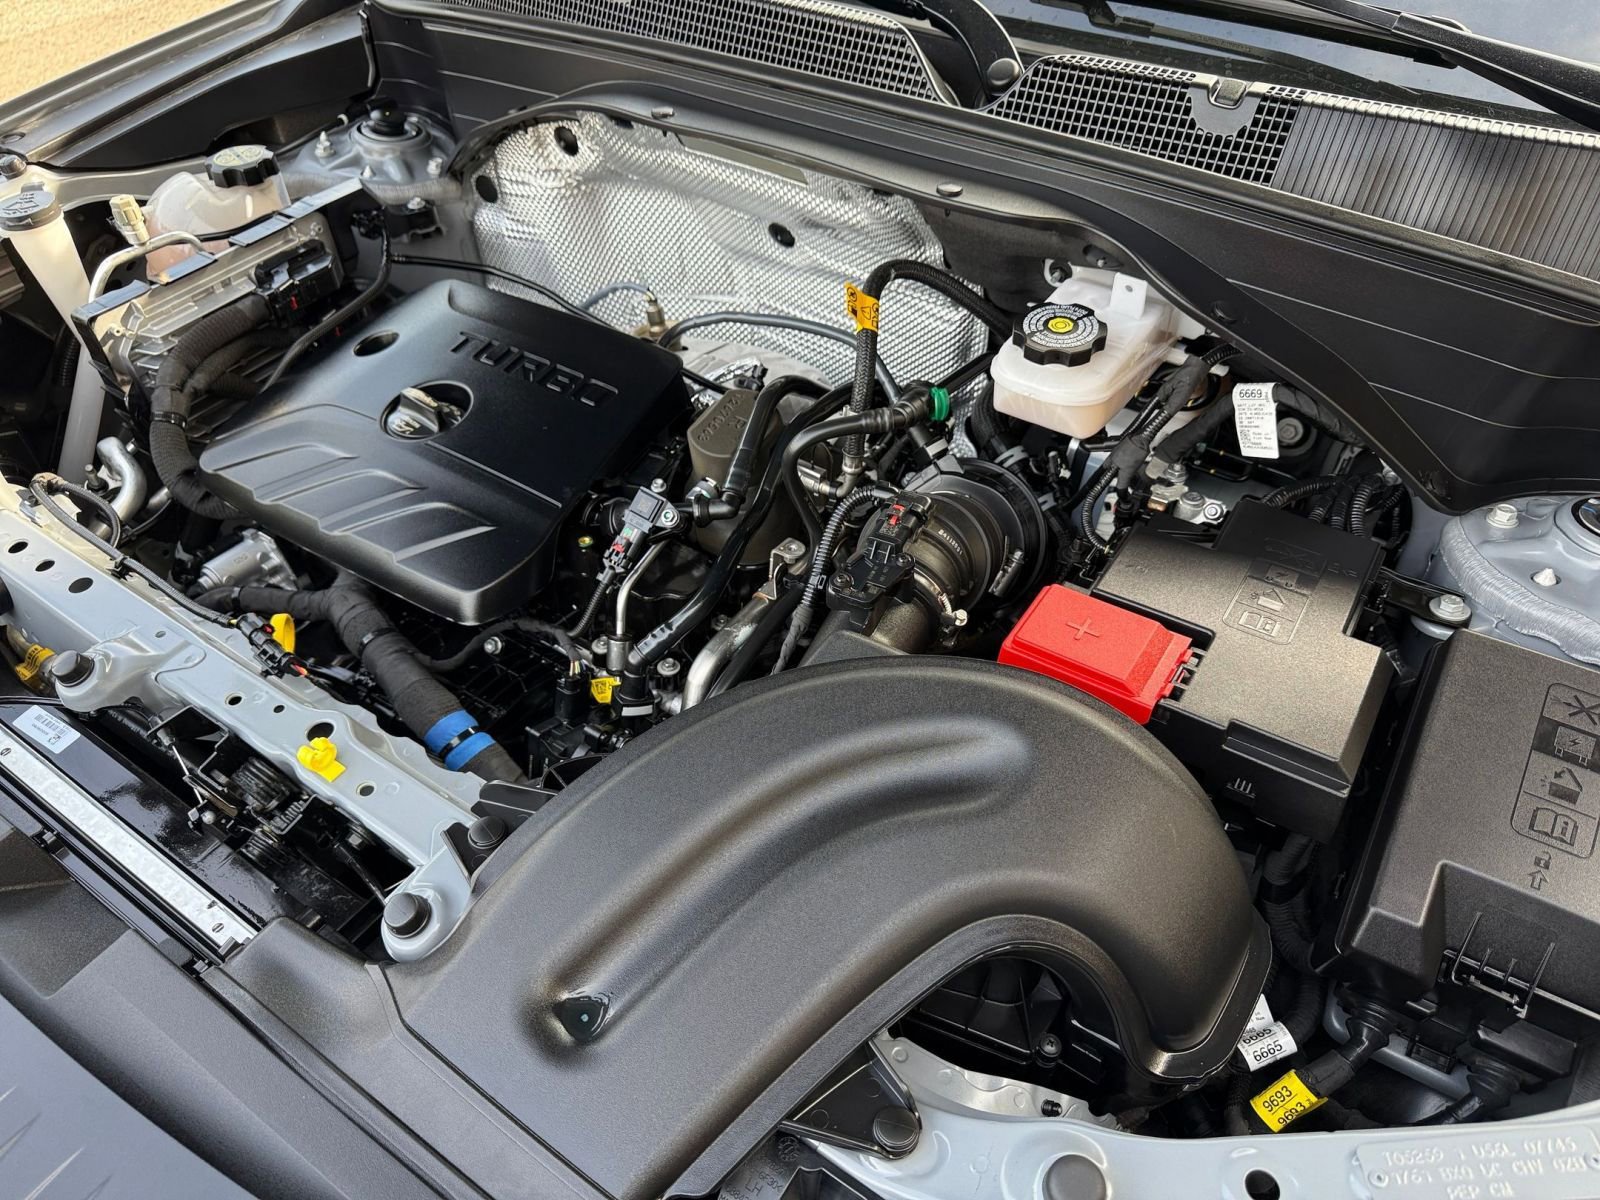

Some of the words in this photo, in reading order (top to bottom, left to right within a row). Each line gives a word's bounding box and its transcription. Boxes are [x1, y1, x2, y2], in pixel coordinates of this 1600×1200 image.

[450, 331, 619, 407] TURBO
[1239, 388, 1262, 399] 6669
[1252, 1039, 1283, 1062] 6665
[1262, 1085, 1293, 1112] 9693
